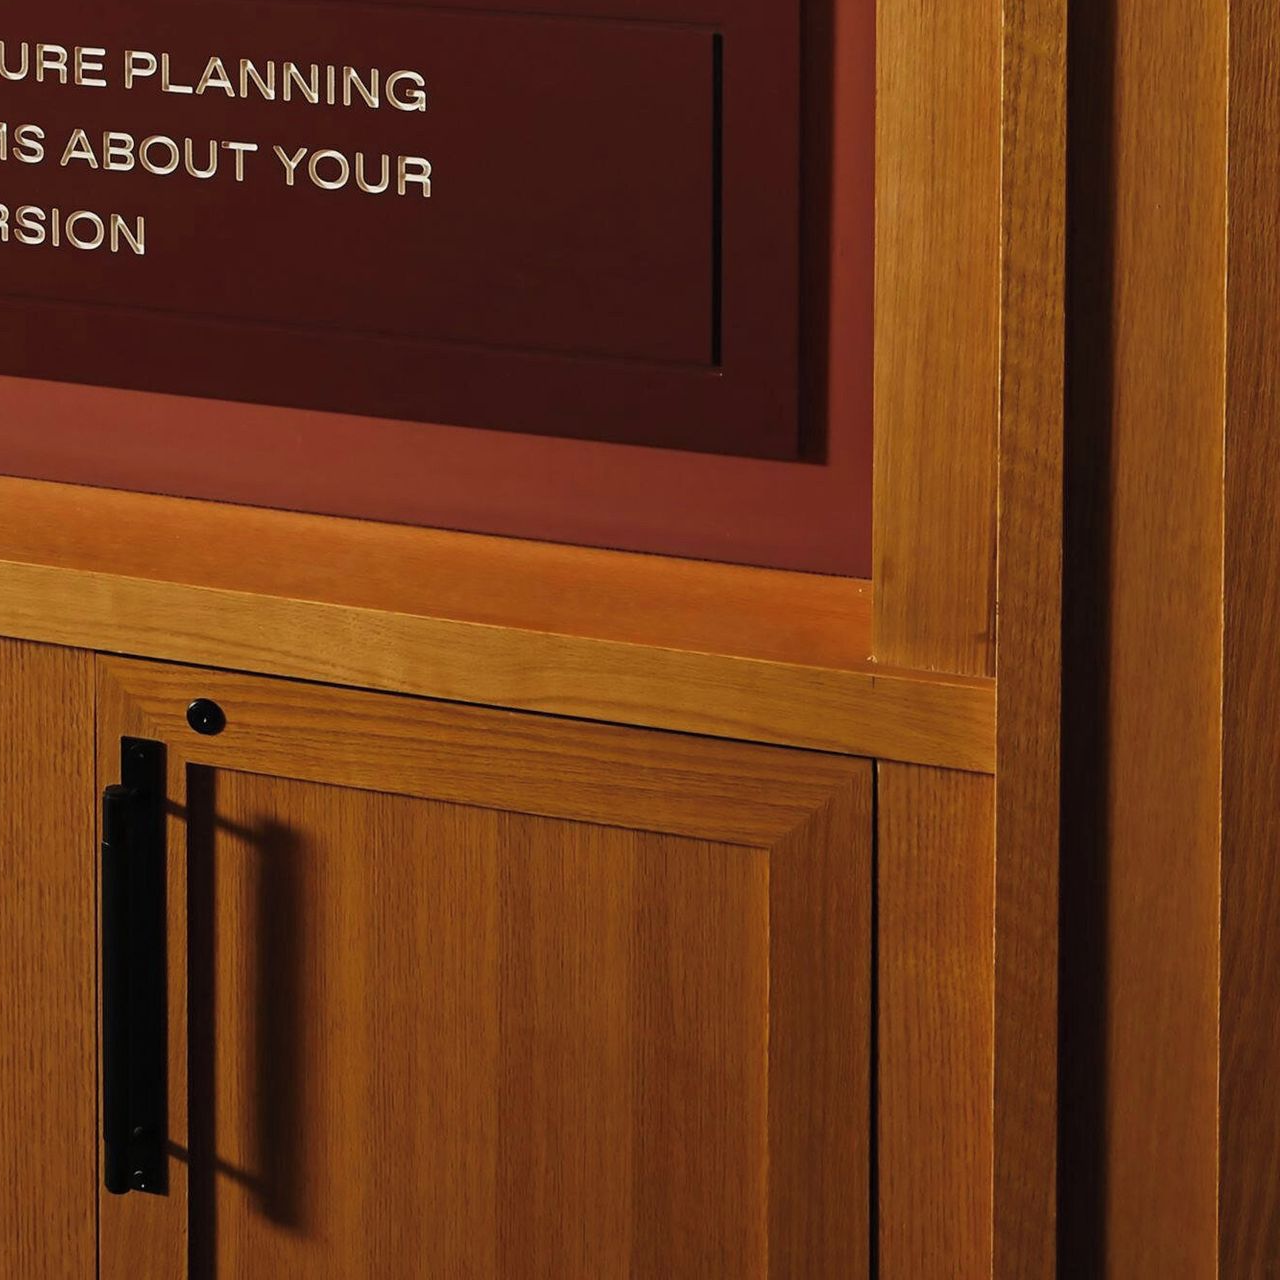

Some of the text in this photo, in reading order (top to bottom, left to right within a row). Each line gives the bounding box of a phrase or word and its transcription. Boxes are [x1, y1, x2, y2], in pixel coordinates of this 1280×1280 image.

[125, 50, 426, 112] PLANNING
[60, 129, 258, 181] ABOUT
[273, 146, 432, 197] YOUR
